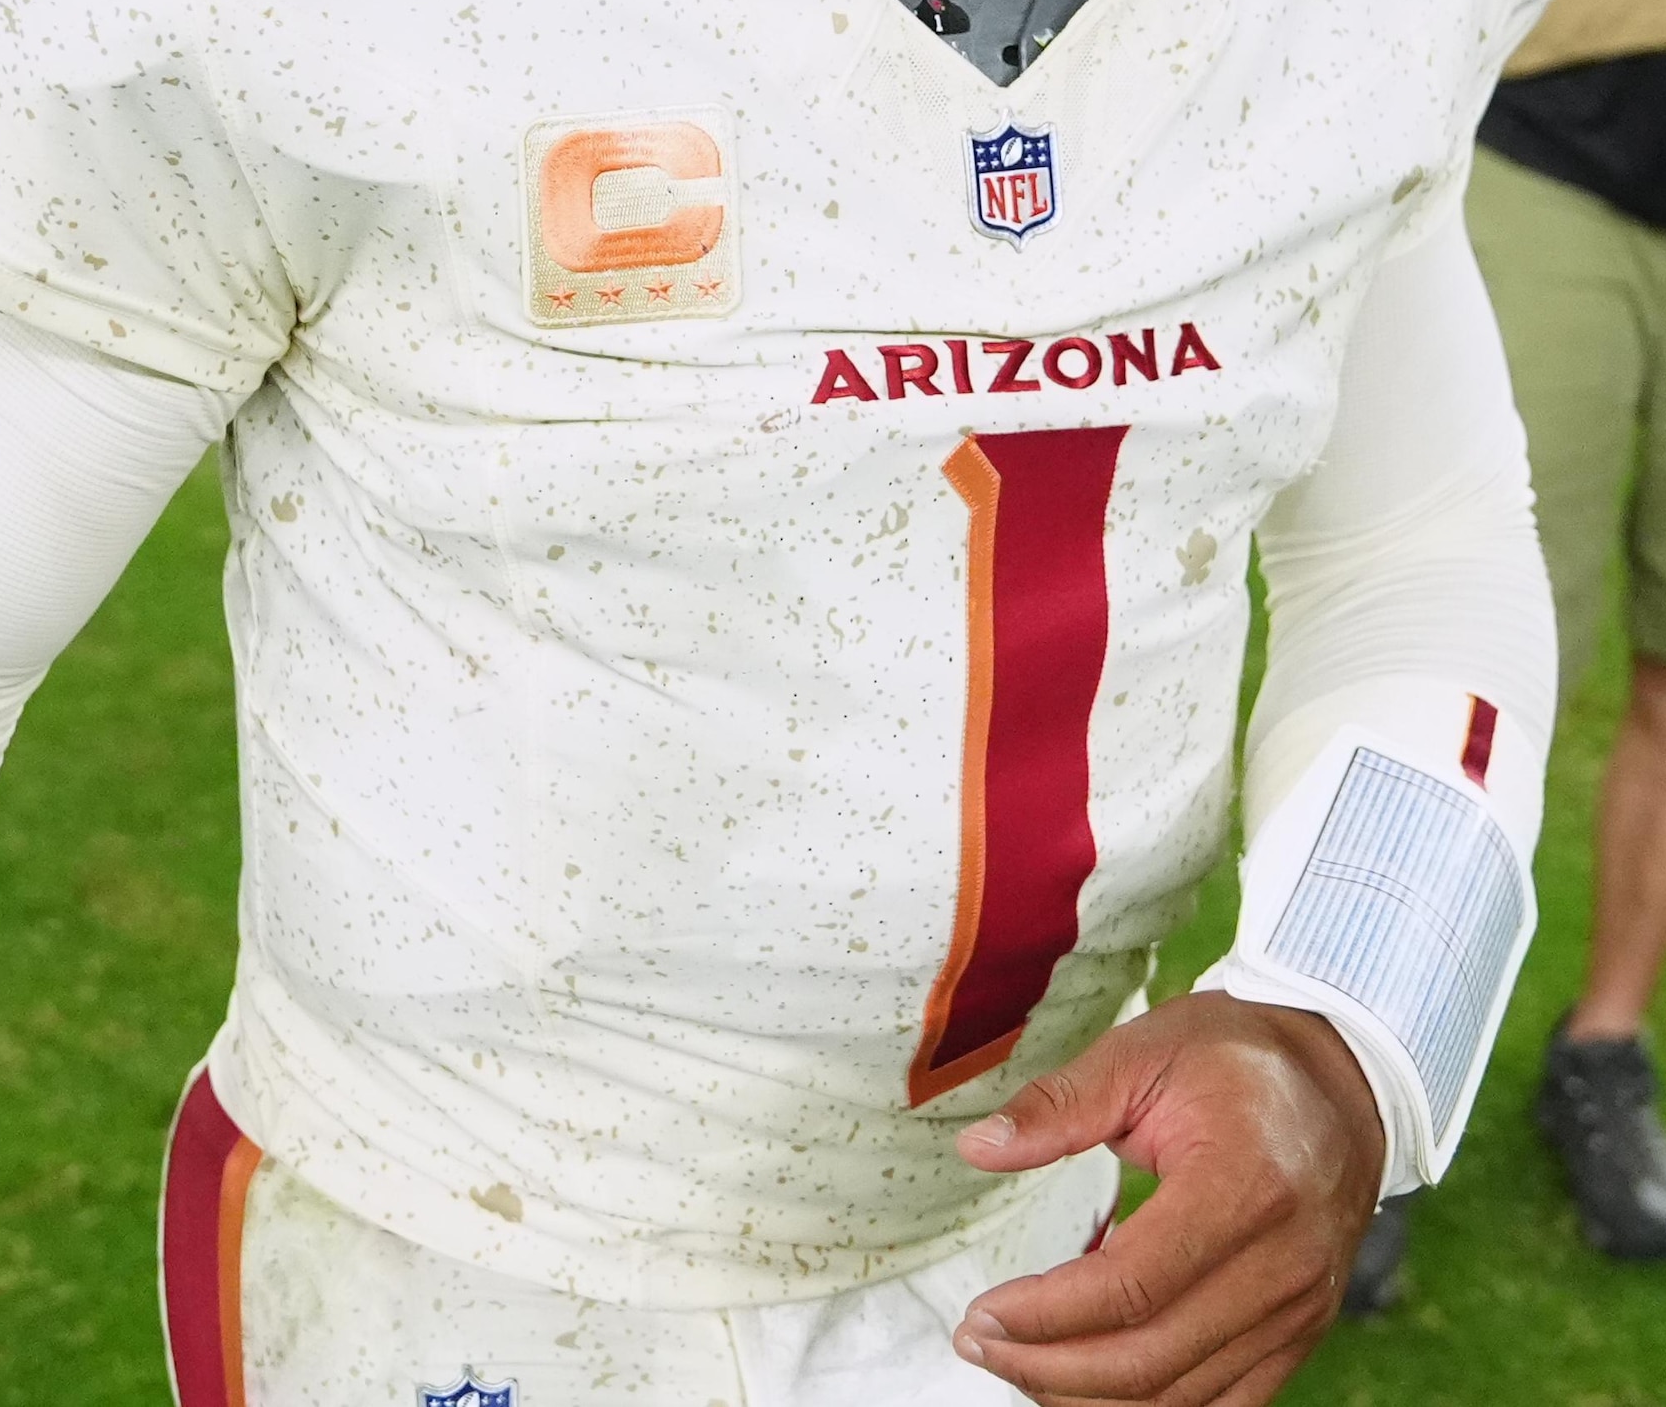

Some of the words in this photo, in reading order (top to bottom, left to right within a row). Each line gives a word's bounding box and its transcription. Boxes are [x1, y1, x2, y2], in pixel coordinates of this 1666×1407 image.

[541, 121, 723, 273] C
[984, 172, 1048, 223] NFL
[810, 322, 1221, 403] ARIZONA
[907, 425, 1131, 1109] 1
